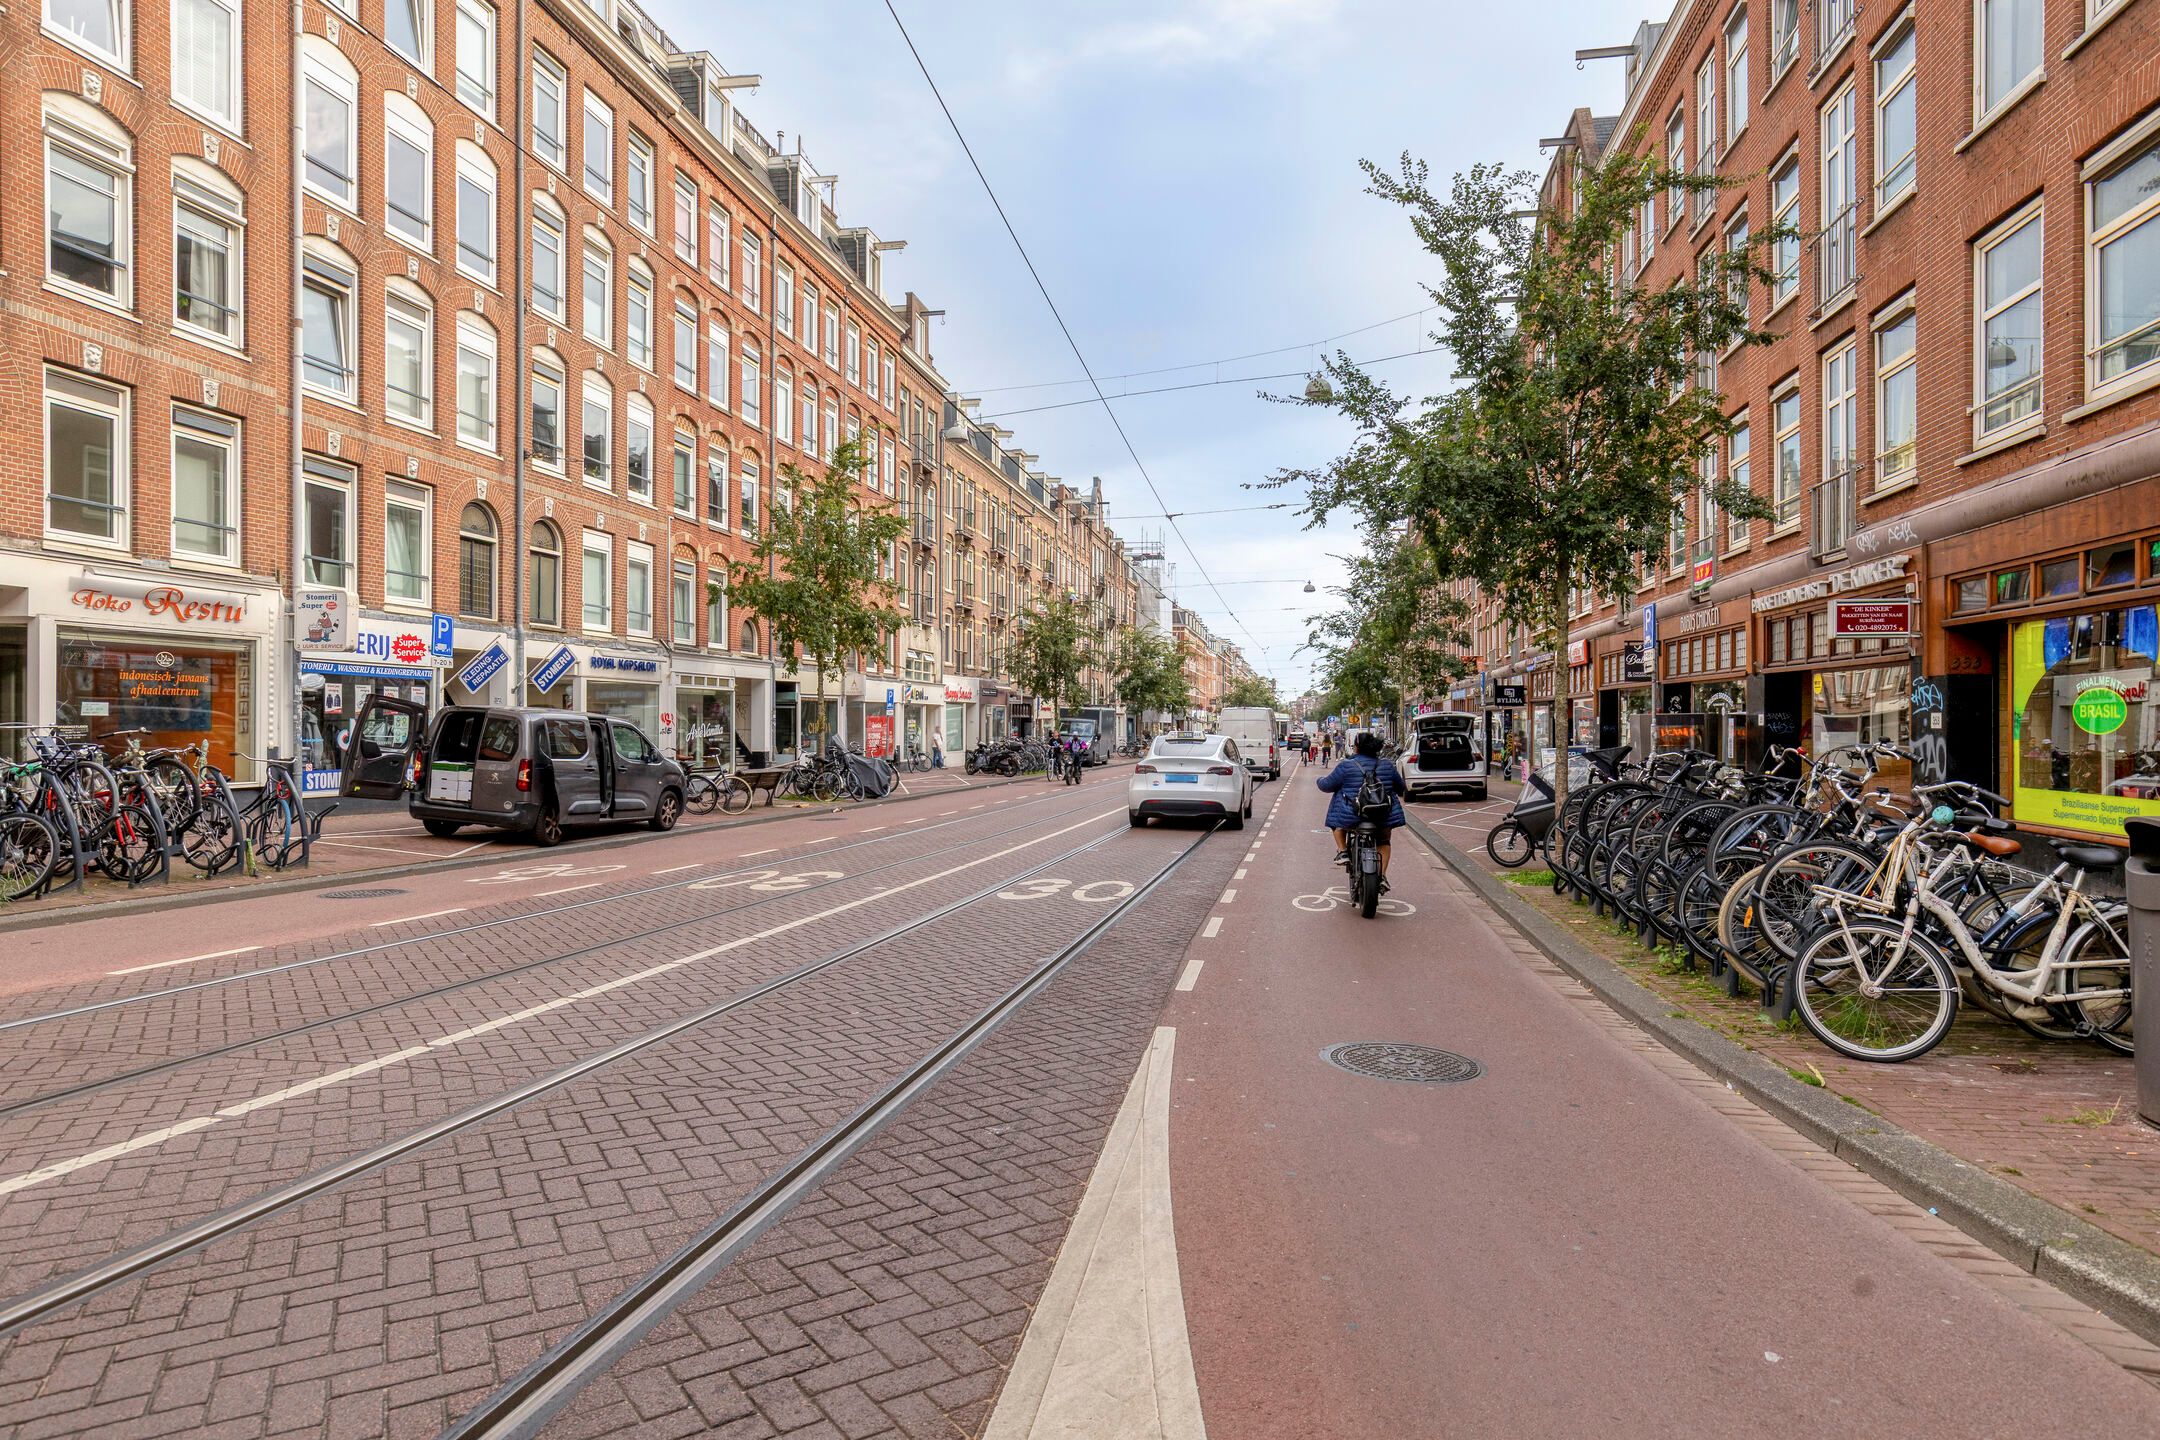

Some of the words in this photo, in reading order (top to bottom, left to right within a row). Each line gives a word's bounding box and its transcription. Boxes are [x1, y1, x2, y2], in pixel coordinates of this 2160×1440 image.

[72, 588, 132, 613] Toko
[144, 587, 243, 623] Restu
[305, 593, 338, 601] Stomerij
[438, 619, 449, 639] P
[356, 632, 391, 661] ERIJ
[397, 647, 424, 657] Service
[399, 638, 421, 649] Super
[338, 664, 370, 674] WASSERIJ
[376, 667, 433, 678] KLEDINGREPARATIE
[462, 654, 494, 683] KLEDING-
[472, 653, 507, 687] REPARATIE
[590, 656, 616, 670] ROYAL
[618, 659, 657, 673] KAPSALON
[129, 683, 162, 699] afhaal
[162, 687, 199, 698] centrum
[2076, 675, 2129, 695] FINALMENTE
[2079, 703, 2121, 719] BRASIL
[2061, 797, 2099, 811] Braziliaanse
[2100, 802, 2140, 816] Supermarkt
[2053, 808, 2098, 824] Supermercado
[996, 878, 1135, 902] 30
